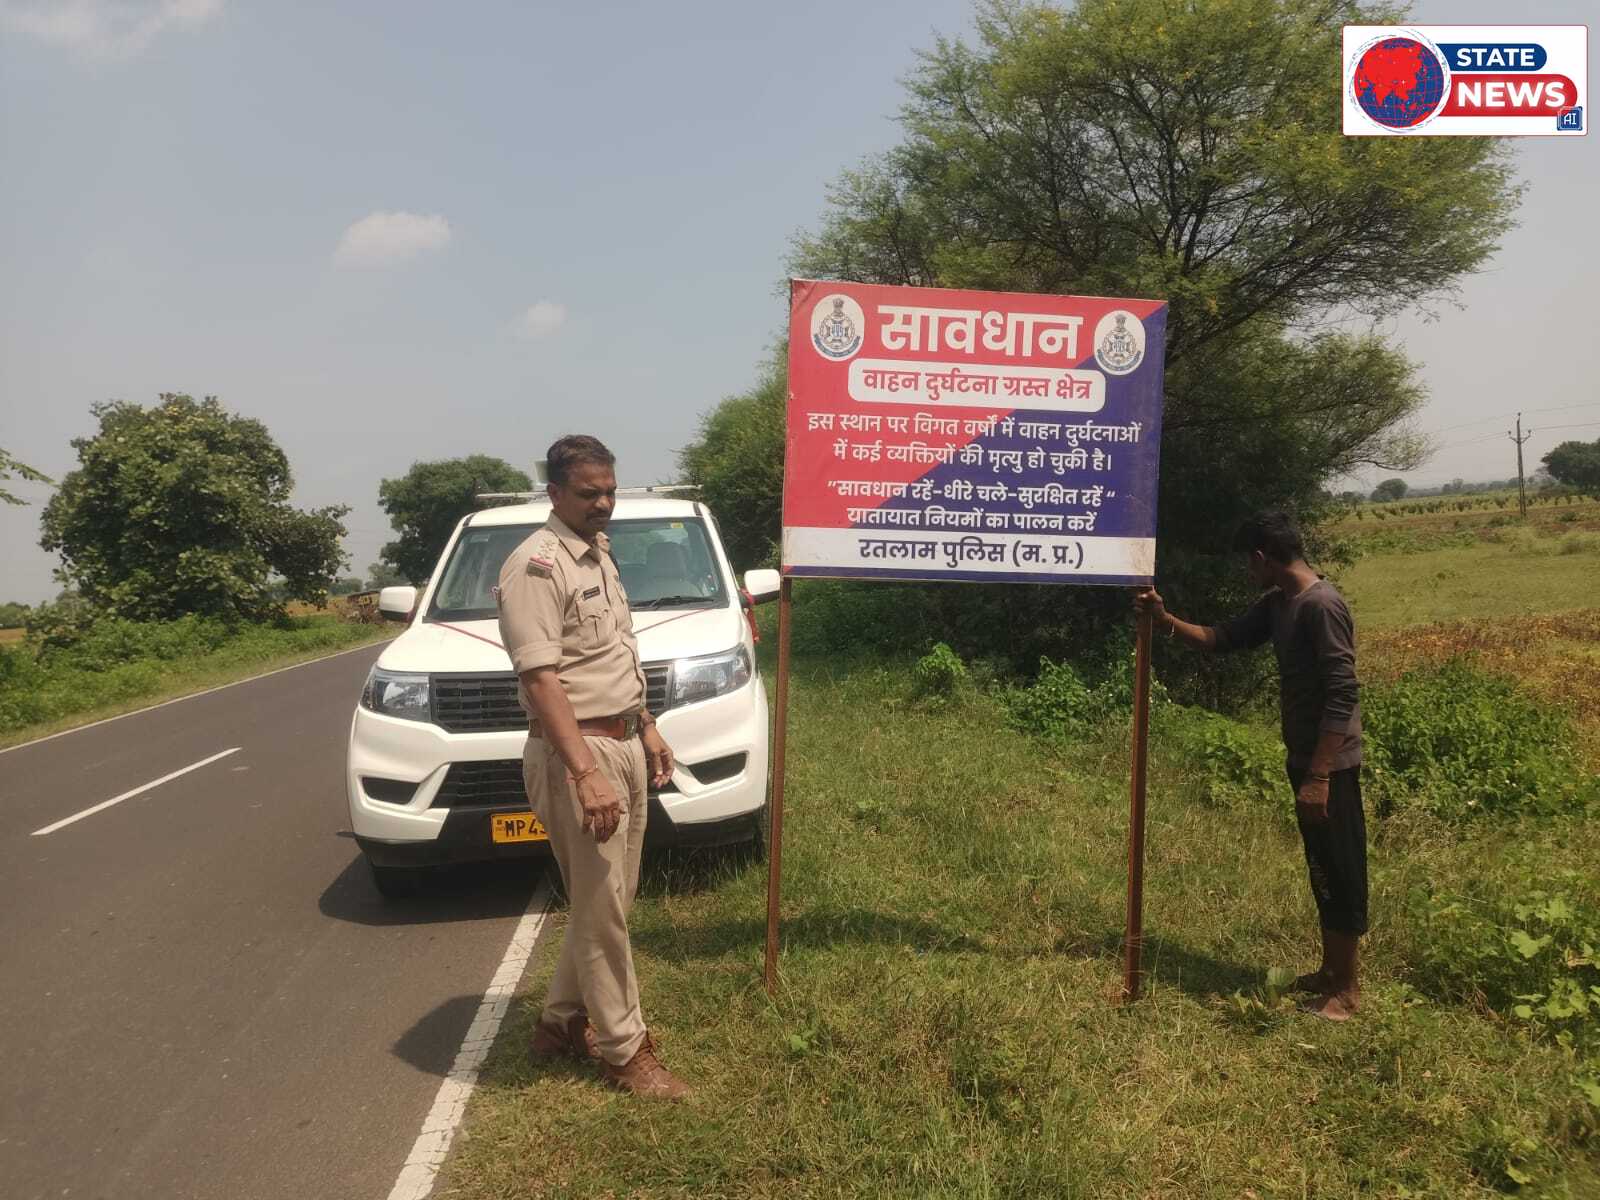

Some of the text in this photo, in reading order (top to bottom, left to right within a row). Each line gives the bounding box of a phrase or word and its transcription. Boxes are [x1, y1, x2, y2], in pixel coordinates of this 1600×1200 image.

[878, 304, 1083, 360] सावधान
[862, 367, 1093, 401] वाहन दुर्घटना ग्रस्त क्षेत्र
[807, 412, 1142, 447] इस स्थान पर विगत वर्षों में वाहन दुर्घटनाओं
[833, 438, 848, 460] में
[851, 439, 883, 463] कई
[886, 441, 956, 464] व्यक्तियों
[959, 443, 984, 465] की
[988, 449, 1023, 473] मृत्यु
[1026, 446, 1046, 468] हो
[1050, 448, 1088, 475] चुकी
[846, 505, 1097, 532] यातायात नियमों का पालन करें
[858, 538, 938, 560] रतलाम
[942, 535, 1007, 568] पुलिस
